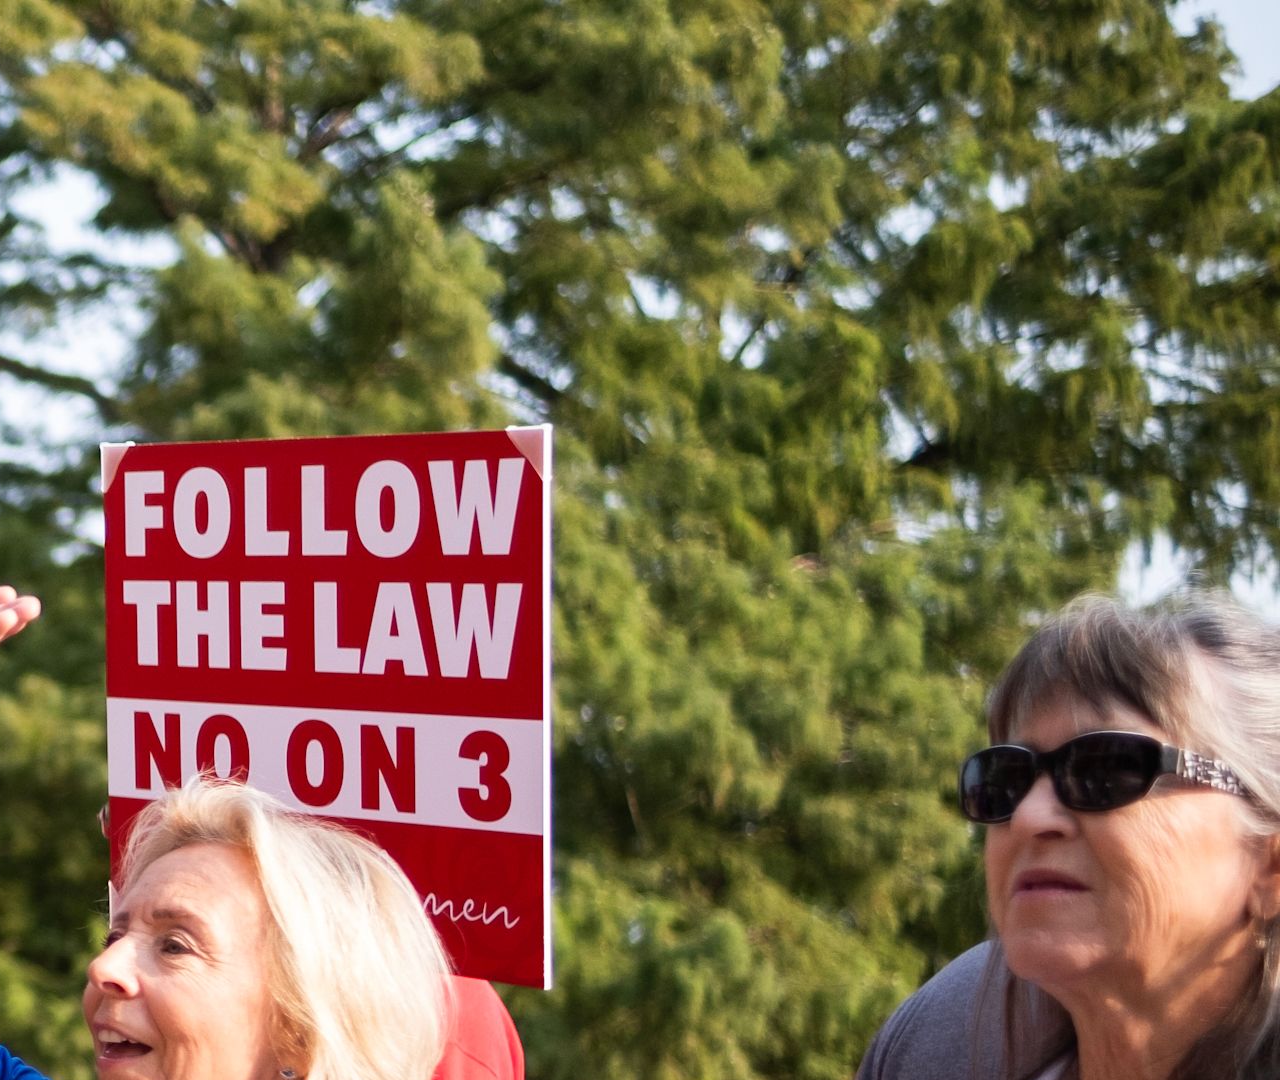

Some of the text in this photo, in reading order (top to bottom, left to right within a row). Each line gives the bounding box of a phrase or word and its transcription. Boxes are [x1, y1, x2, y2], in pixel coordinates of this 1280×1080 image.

[124, 458, 525, 559] FOLLOW
[123, 580, 523, 679] THE LAW
[134, 711, 512, 822] NO ON 3
[423, 891, 520, 930] men
